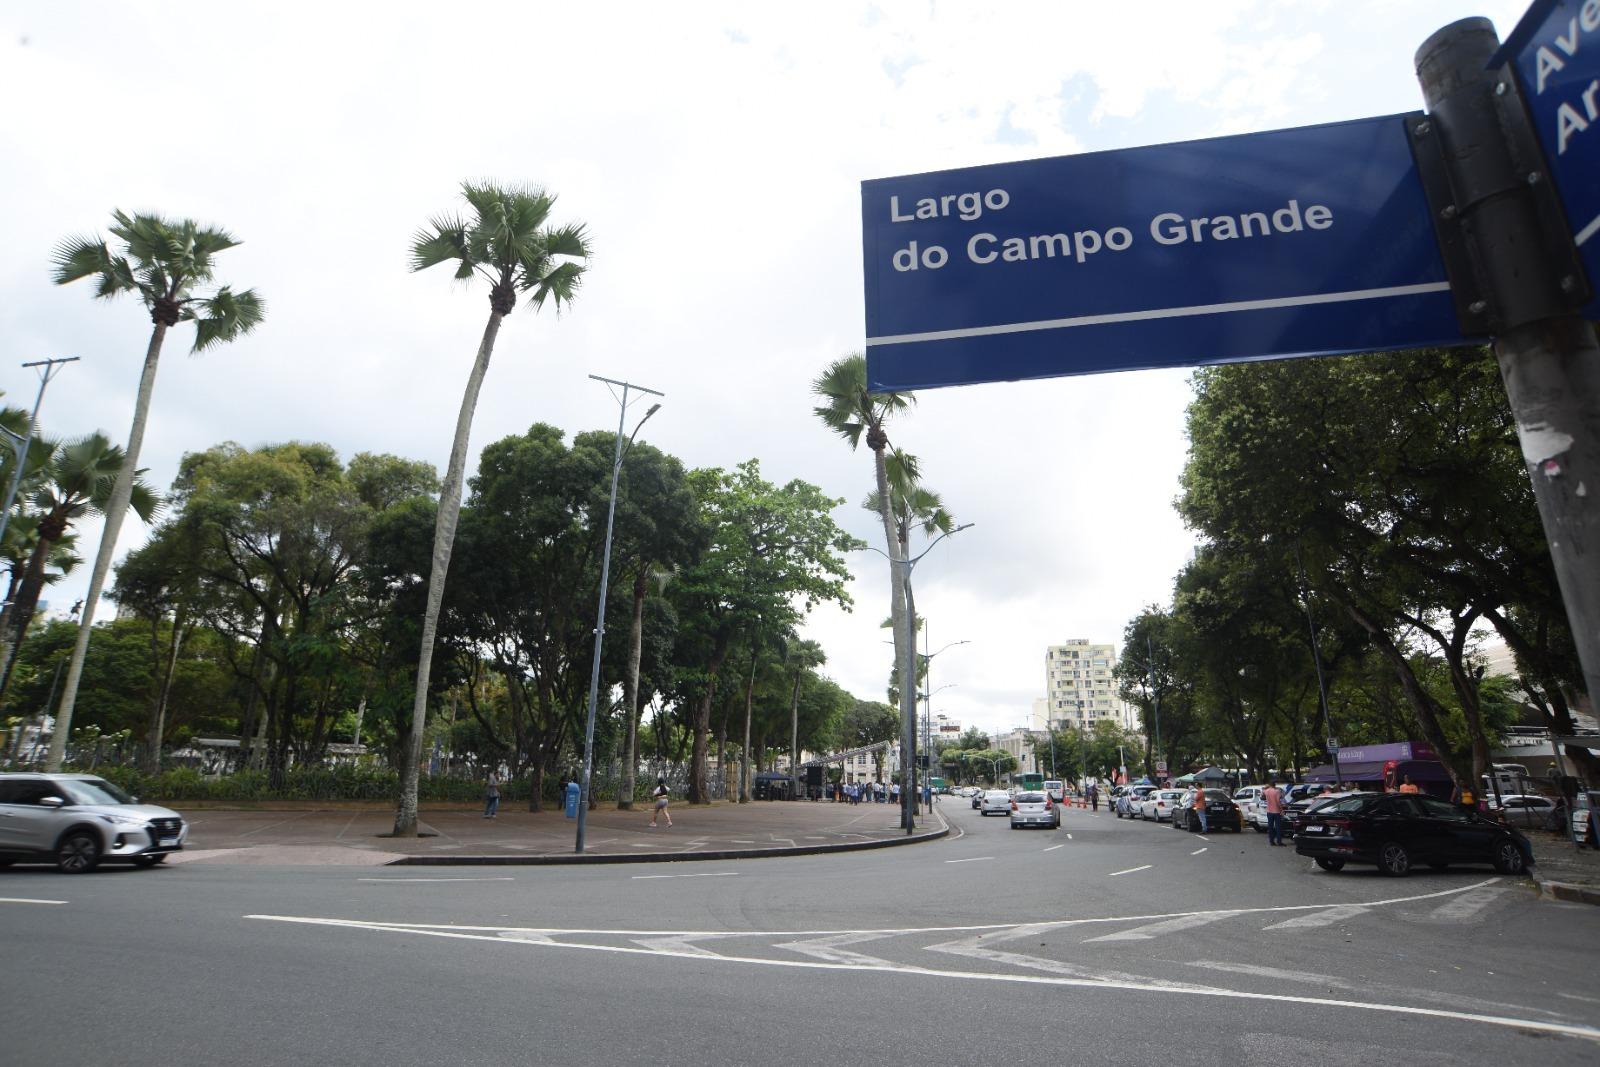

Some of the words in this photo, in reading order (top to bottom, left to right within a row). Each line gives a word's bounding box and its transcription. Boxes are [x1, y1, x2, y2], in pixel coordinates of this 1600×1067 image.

[891, 188, 1010, 222] Largo
[893, 241, 948, 271] do
[967, 226, 1133, 263] Campo
[1151, 200, 1332, 244] Grande
